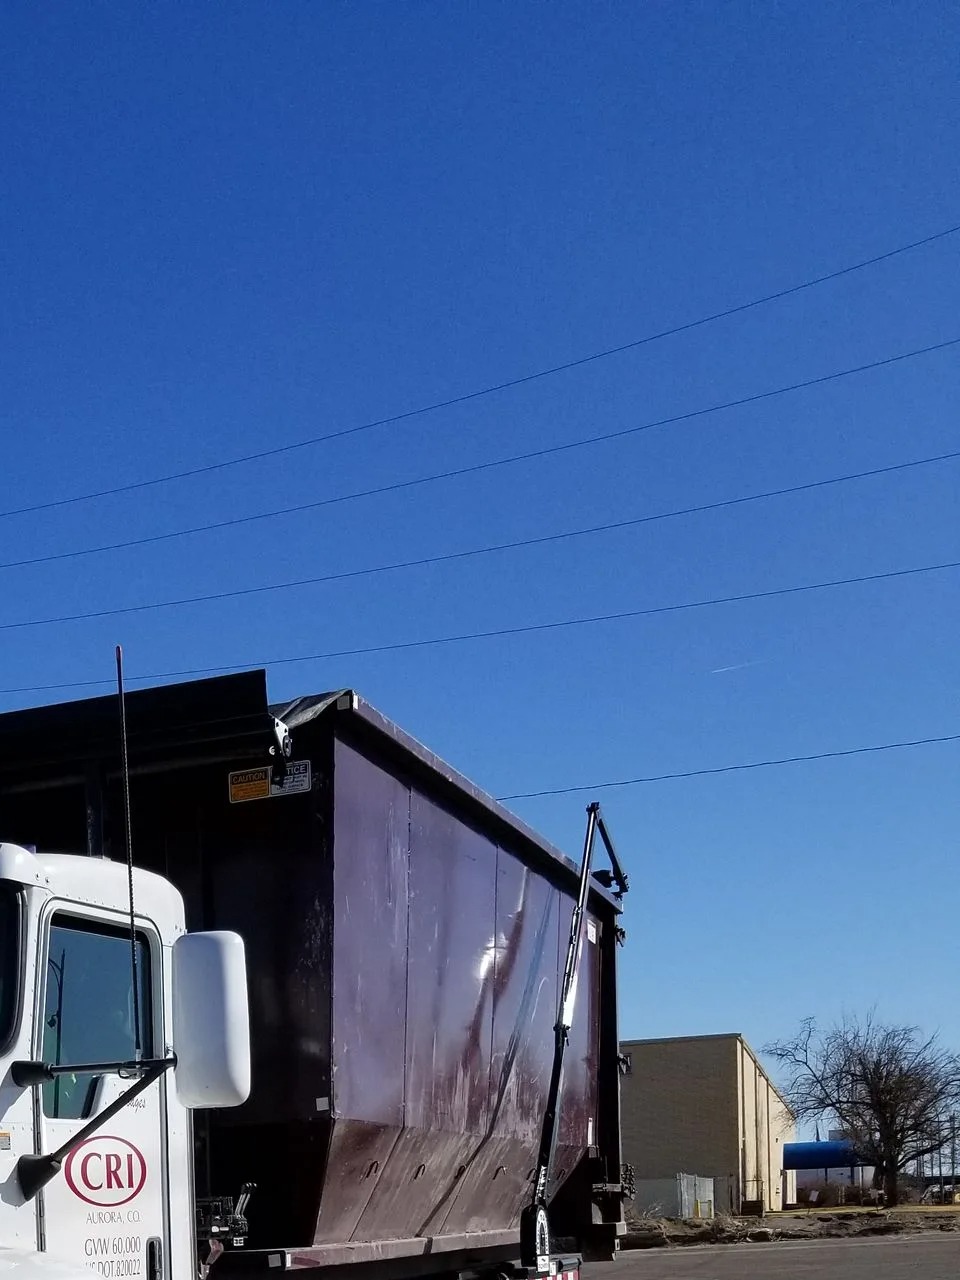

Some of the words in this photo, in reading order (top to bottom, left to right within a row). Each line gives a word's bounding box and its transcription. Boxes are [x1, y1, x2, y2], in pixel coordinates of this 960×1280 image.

[233, 772, 265, 783] CAUTION
[81, 1152, 134, 1191] CRI
[86, 1211, 125, 1225] AURORA,
[84, 1236, 110, 1257] GVW
[112, 1236, 141, 1257] 60,000
